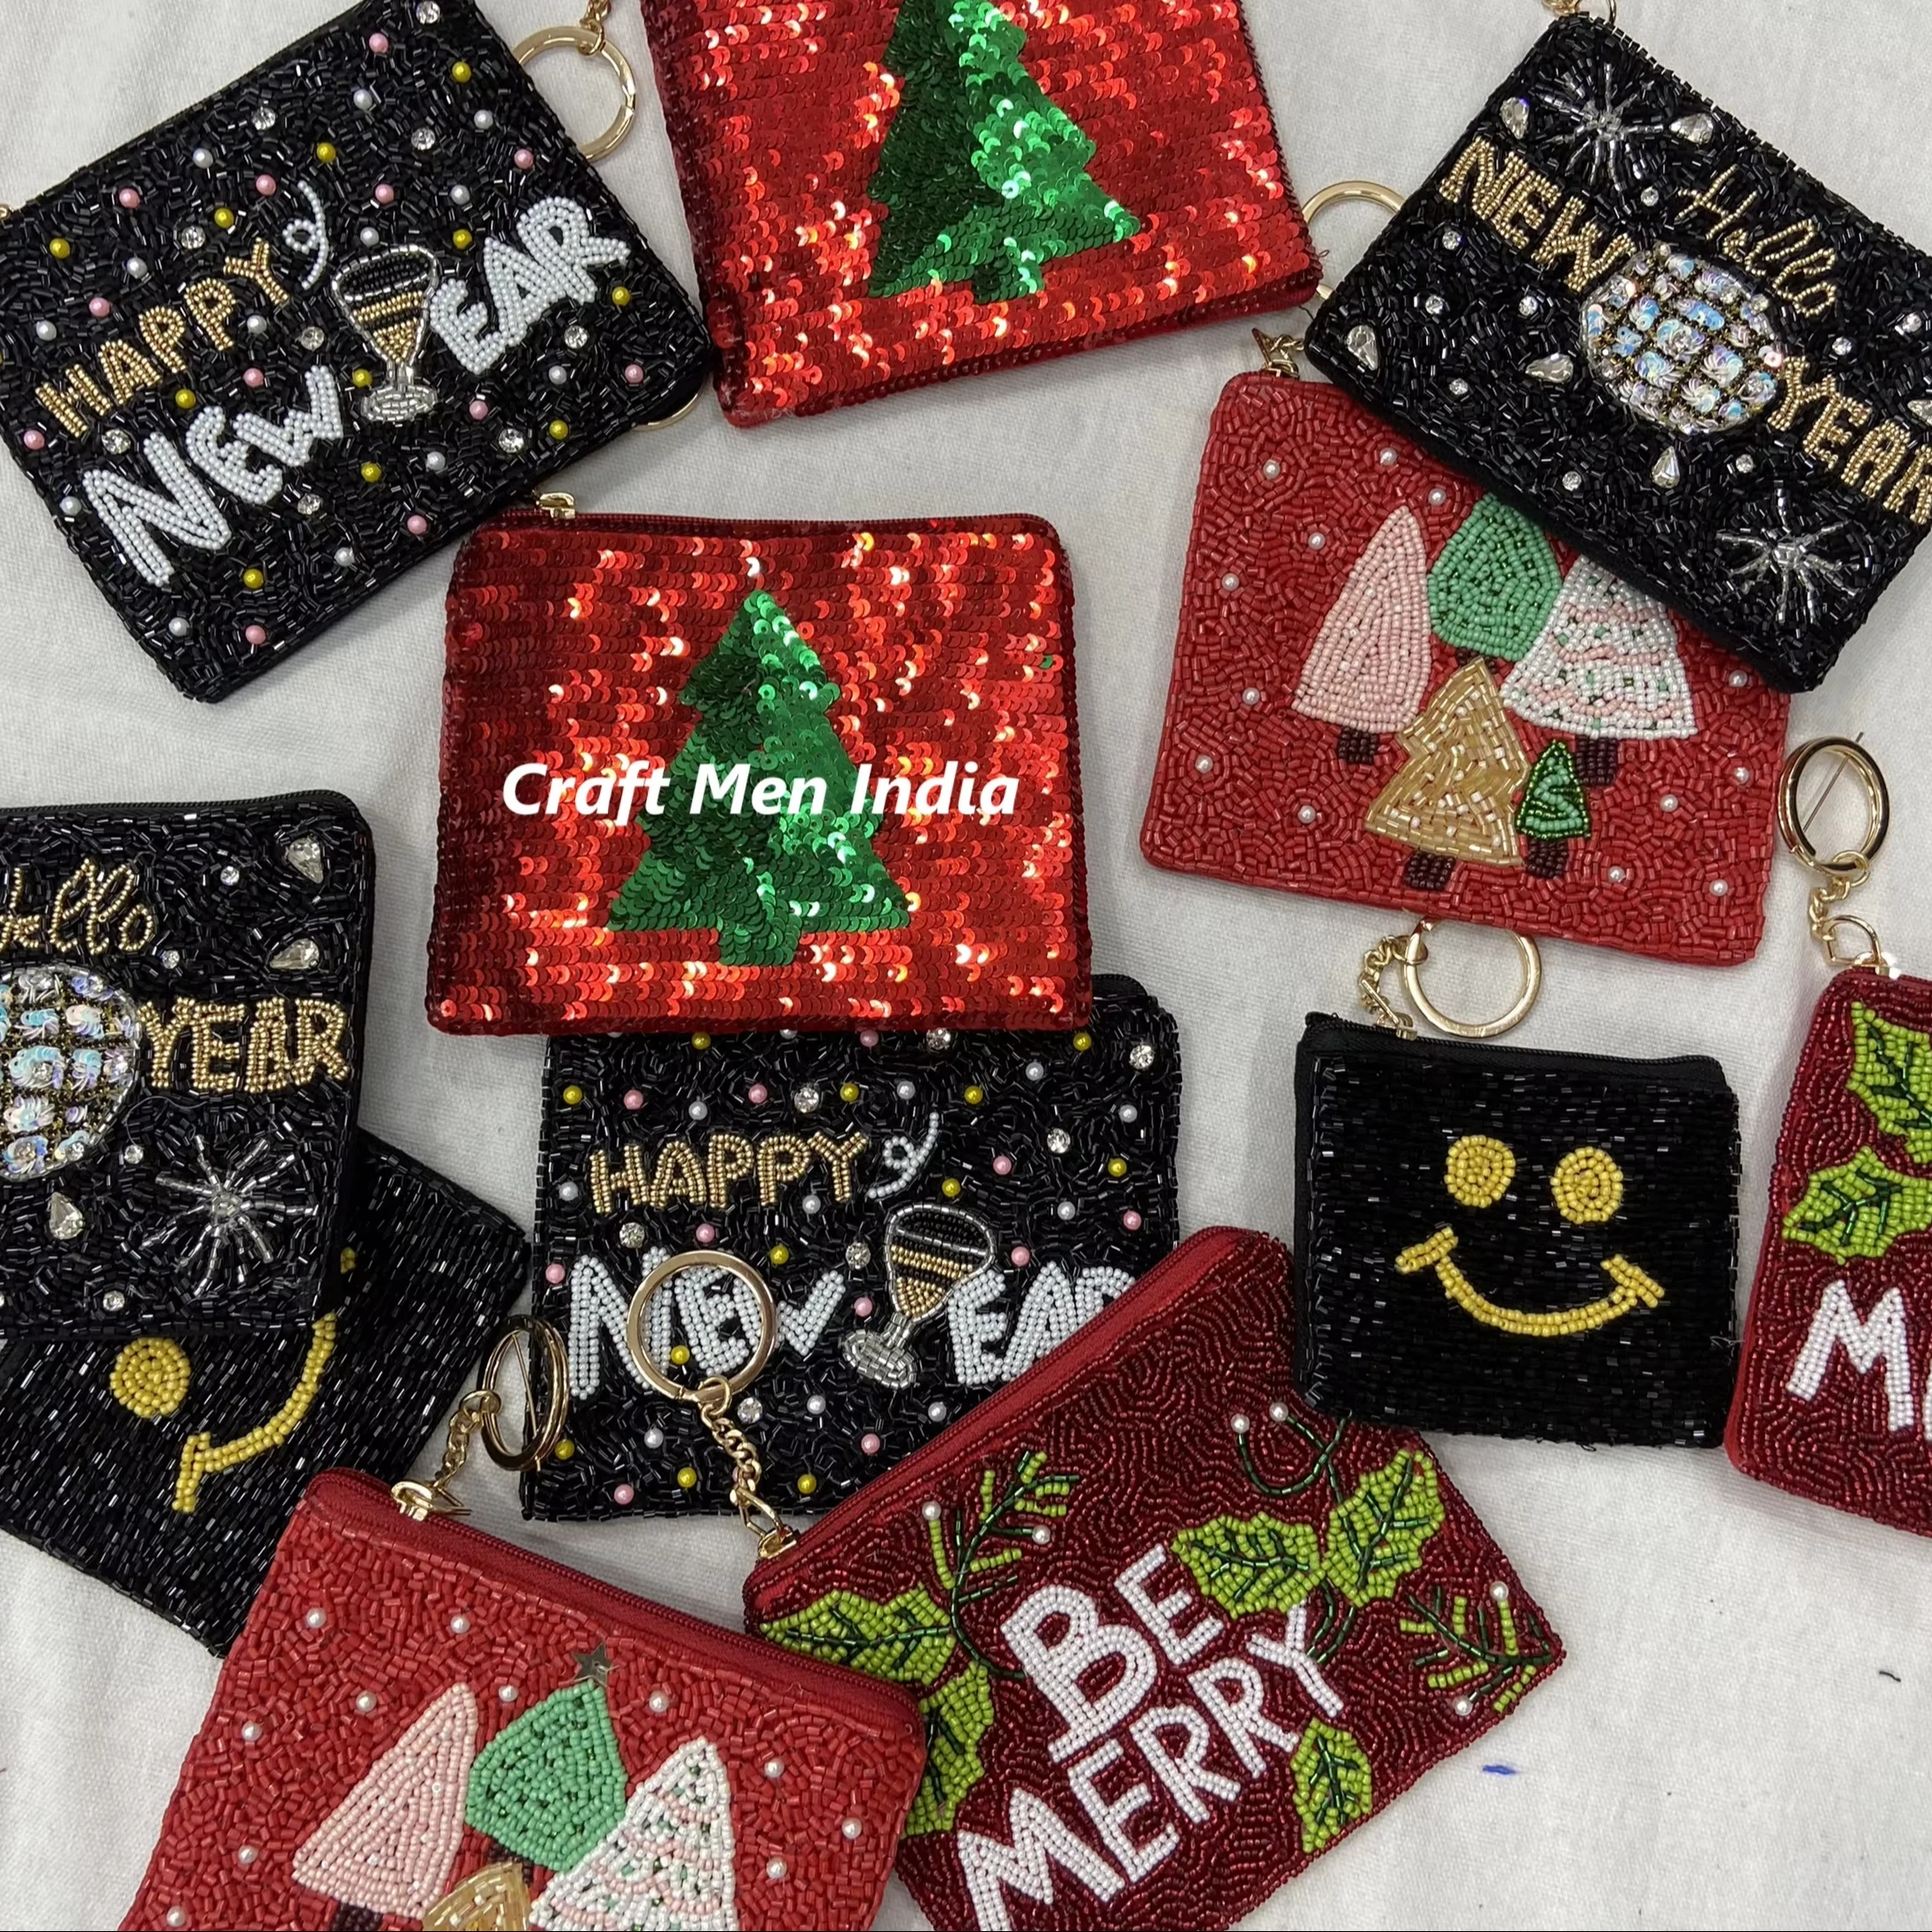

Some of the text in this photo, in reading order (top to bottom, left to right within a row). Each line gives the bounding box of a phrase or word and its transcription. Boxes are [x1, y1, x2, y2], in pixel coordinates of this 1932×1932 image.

[1438, 135, 1637, 294] NEW
[34, 237, 289, 438] HAPPY
[83, 365, 344, 588] NEW
[138, 997, 353, 1094] YEAR
[589, 1131, 869, 1214] HAPPY
[568, 1245, 847, 1400] NEW
[1000, 1542, 1225, 1764] BE
[955, 1599, 1345, 1932] MERRY
